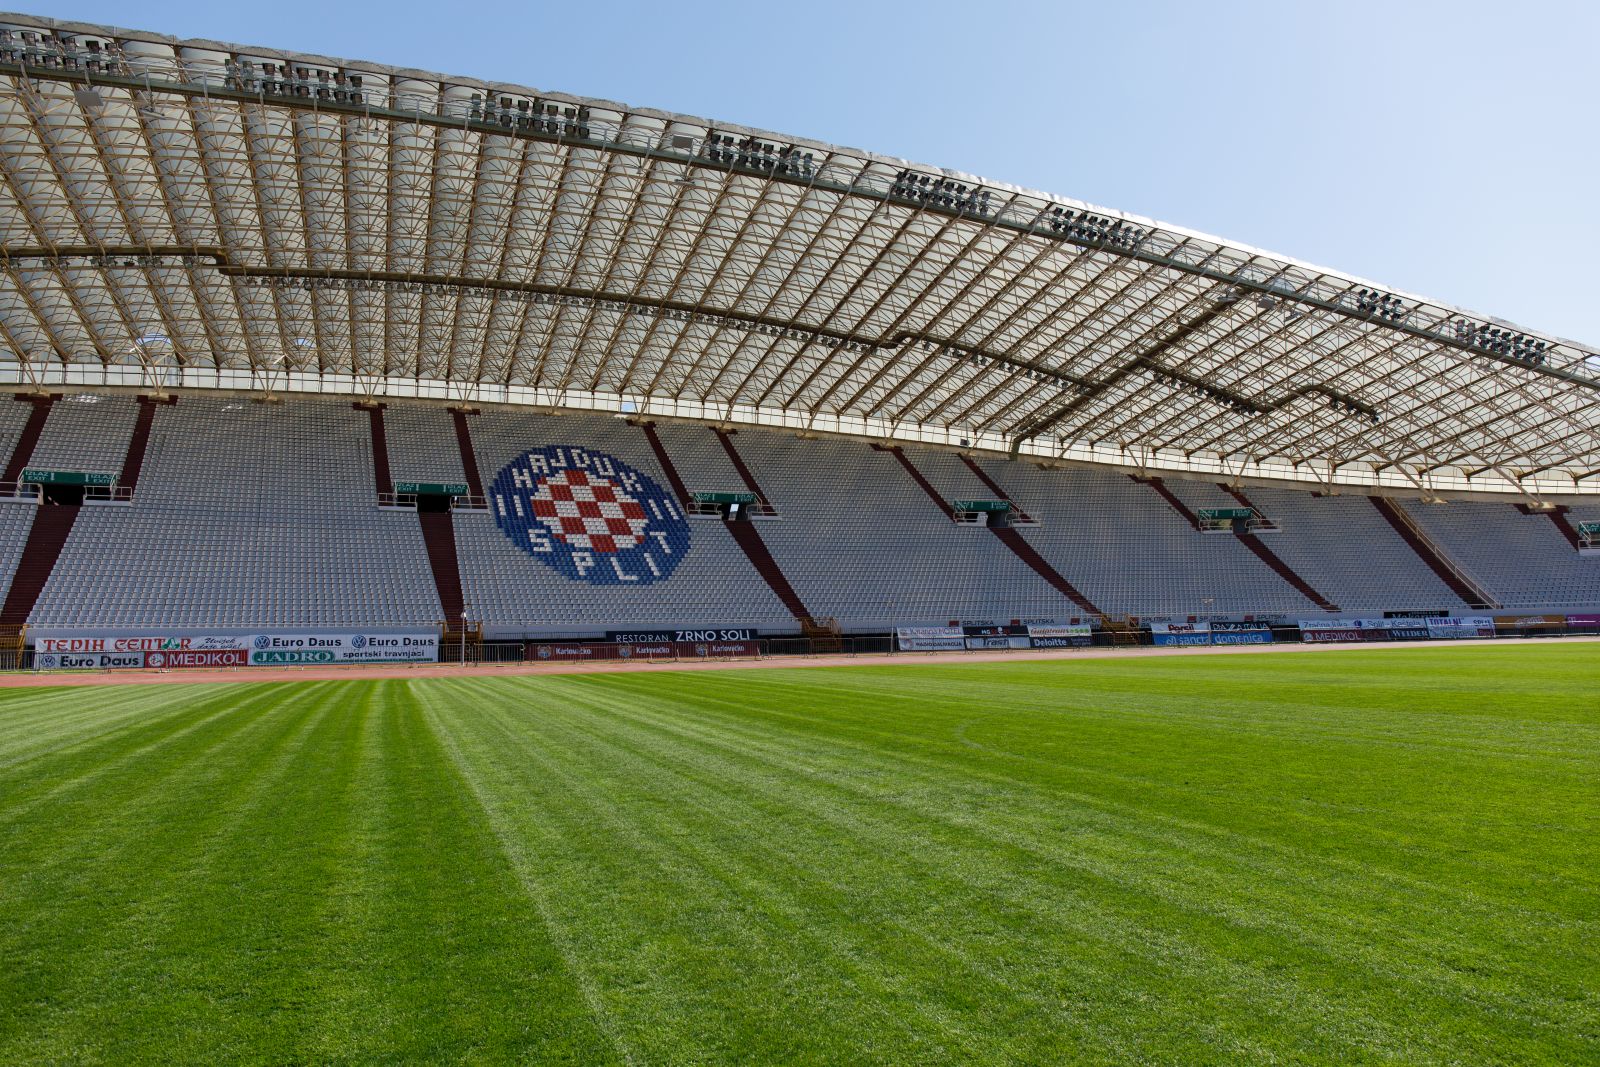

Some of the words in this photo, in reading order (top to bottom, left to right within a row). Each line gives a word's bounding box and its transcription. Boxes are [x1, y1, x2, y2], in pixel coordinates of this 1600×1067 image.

[512, 448, 643, 492] HAJDUK
[528, 529, 671, 581] SPLIT
[272, 637, 304, 647] Euro
[308, 637, 342, 647] Daus
[368, 637, 398, 646] Euro
[403, 637, 434, 646] Daus
[616, 634, 669, 643] RESTORAN
[676, 630, 717, 642] ZRNO
[720, 630, 750, 641] SOLI
[1214, 632, 1264, 644] domenica
[1315, 631, 1361, 641] MEDIKOL
[114, 637, 192, 650] CENTAR
[1034, 638, 1067, 647] Deloitte
[169, 653, 245, 665] MEDIKOL
[257, 652, 331, 662] JADRO
[343, 650, 382, 659] sportski
[384, 650, 424, 658] travnjaci
[60, 656, 94, 667] Euro
[100, 655, 139, 667] Daus
